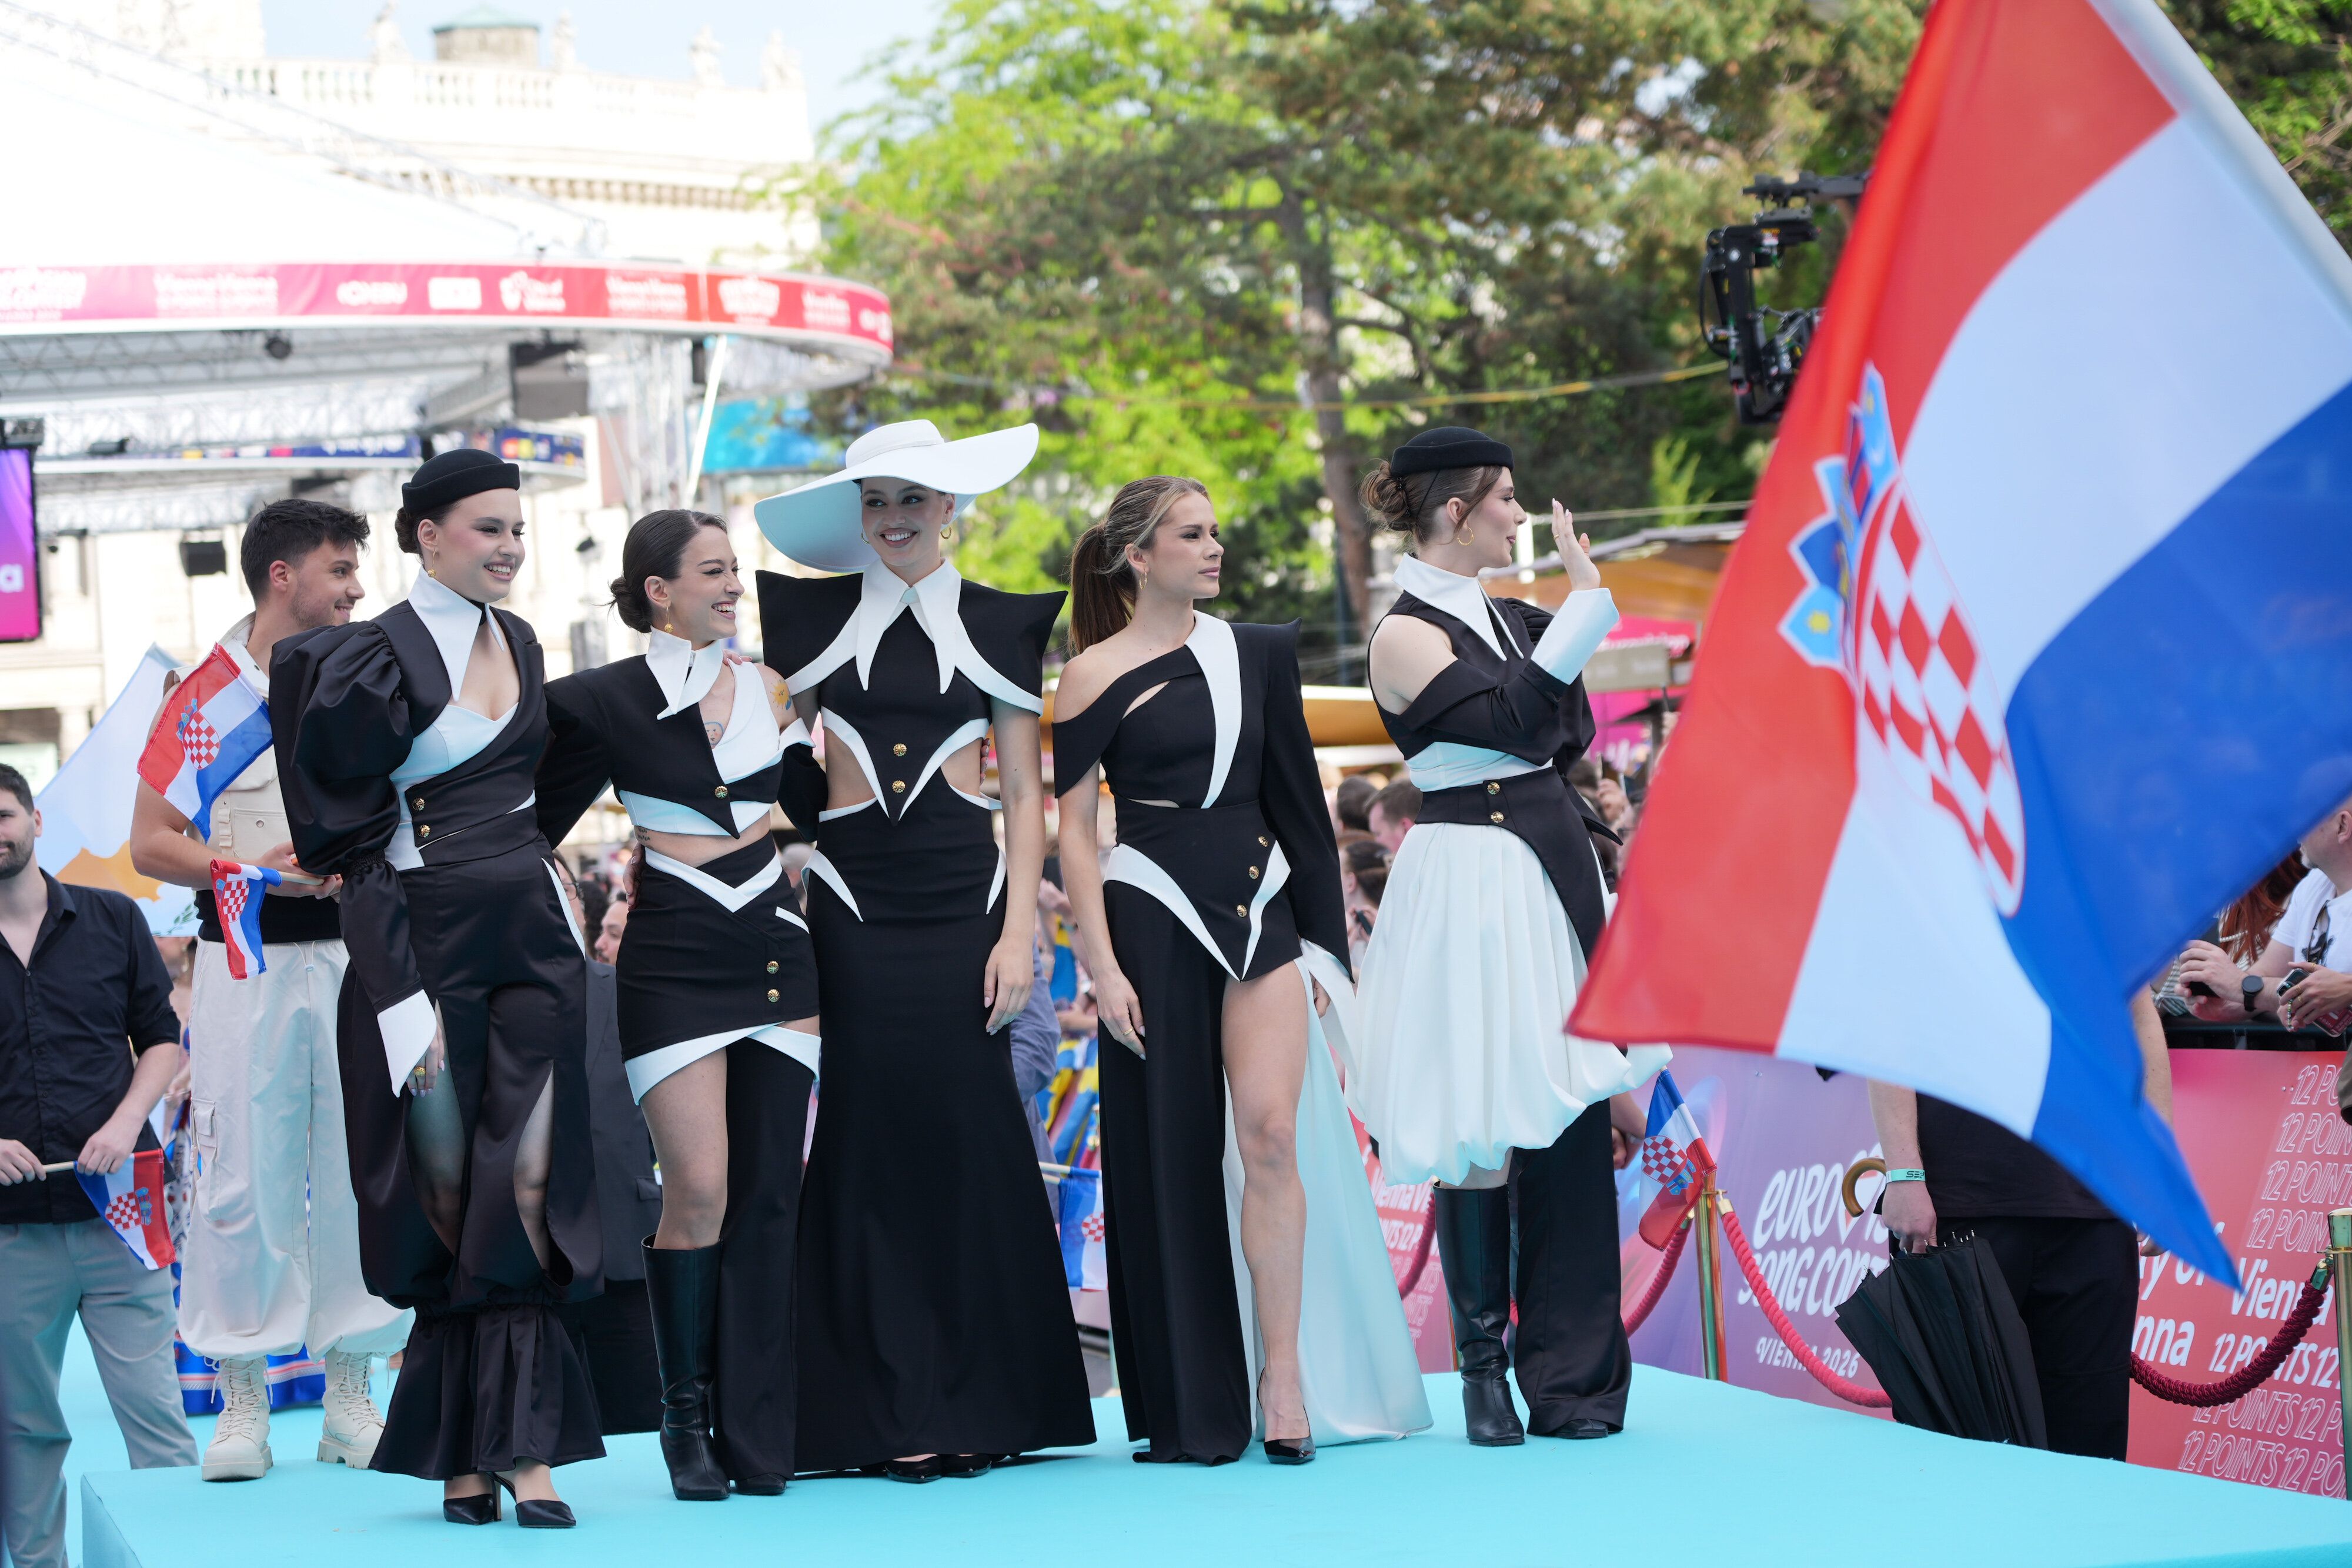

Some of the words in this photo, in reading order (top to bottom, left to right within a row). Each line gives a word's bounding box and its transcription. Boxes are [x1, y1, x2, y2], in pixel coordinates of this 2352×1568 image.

[2291, 1065, 2320, 1105] 12
[2276, 1112, 2304, 1153] 12
[2297, 1112, 2352, 1156] POIN
[2261, 1160, 2290, 1201] 12
[2282, 1161, 2352, 1206] POINT
[2246, 1208, 2275, 1249] 12
[2267, 1209, 2328, 1253] POIN
[2209, 1333, 2236, 1373] 12
[2311, 1346, 2340, 1389] 12
[2294, 1397, 2326, 1440] 12
[2178, 1430, 2206, 1472] 12
[2197, 1432, 2287, 1486] POINTS
[2277, 1447, 2310, 1491] 12
